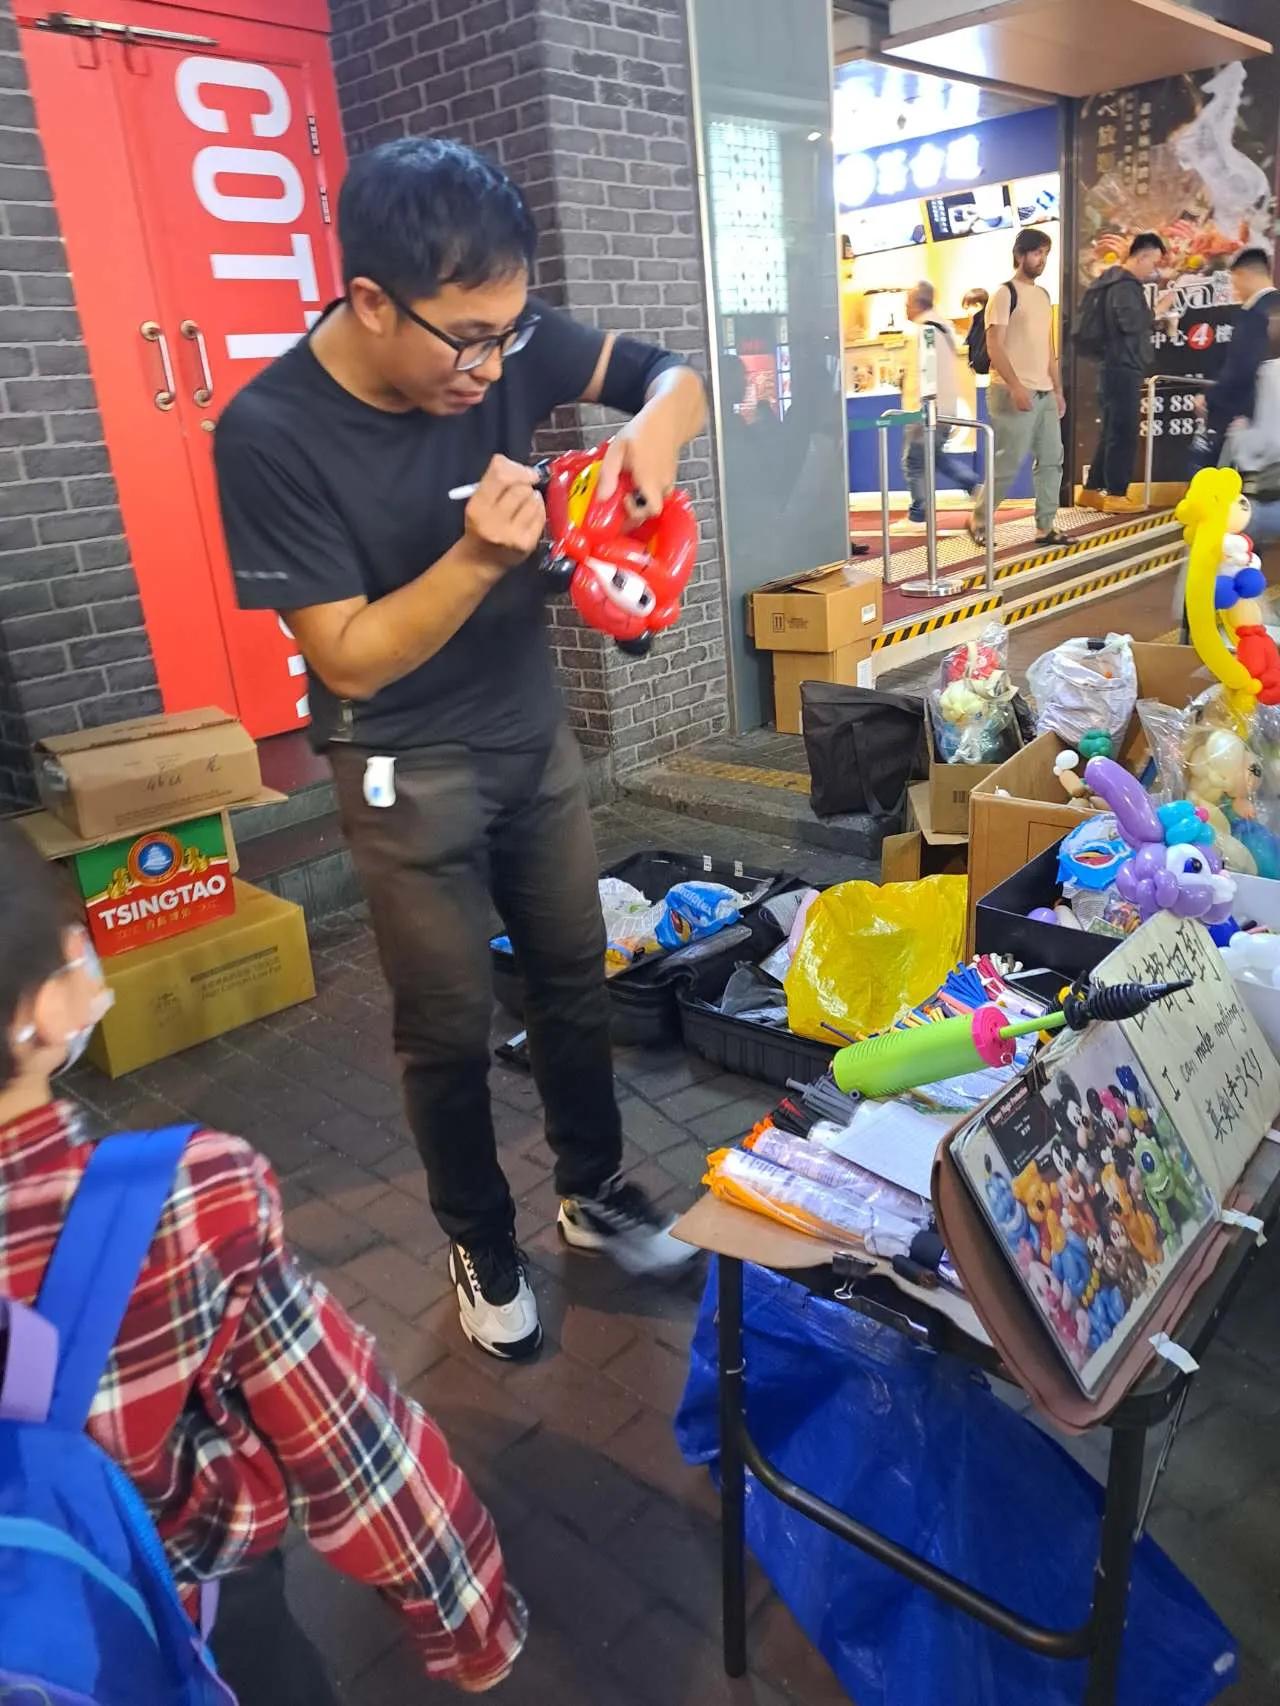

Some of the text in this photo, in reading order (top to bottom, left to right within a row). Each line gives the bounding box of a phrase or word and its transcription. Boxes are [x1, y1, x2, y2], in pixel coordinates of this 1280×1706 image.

[98, 874, 226, 930] TSINGTAO
[1161, 1065, 1181, 1102] I
[1180, 1061, 1200, 1084] can
[1195, 1025, 1215, 1066] make
